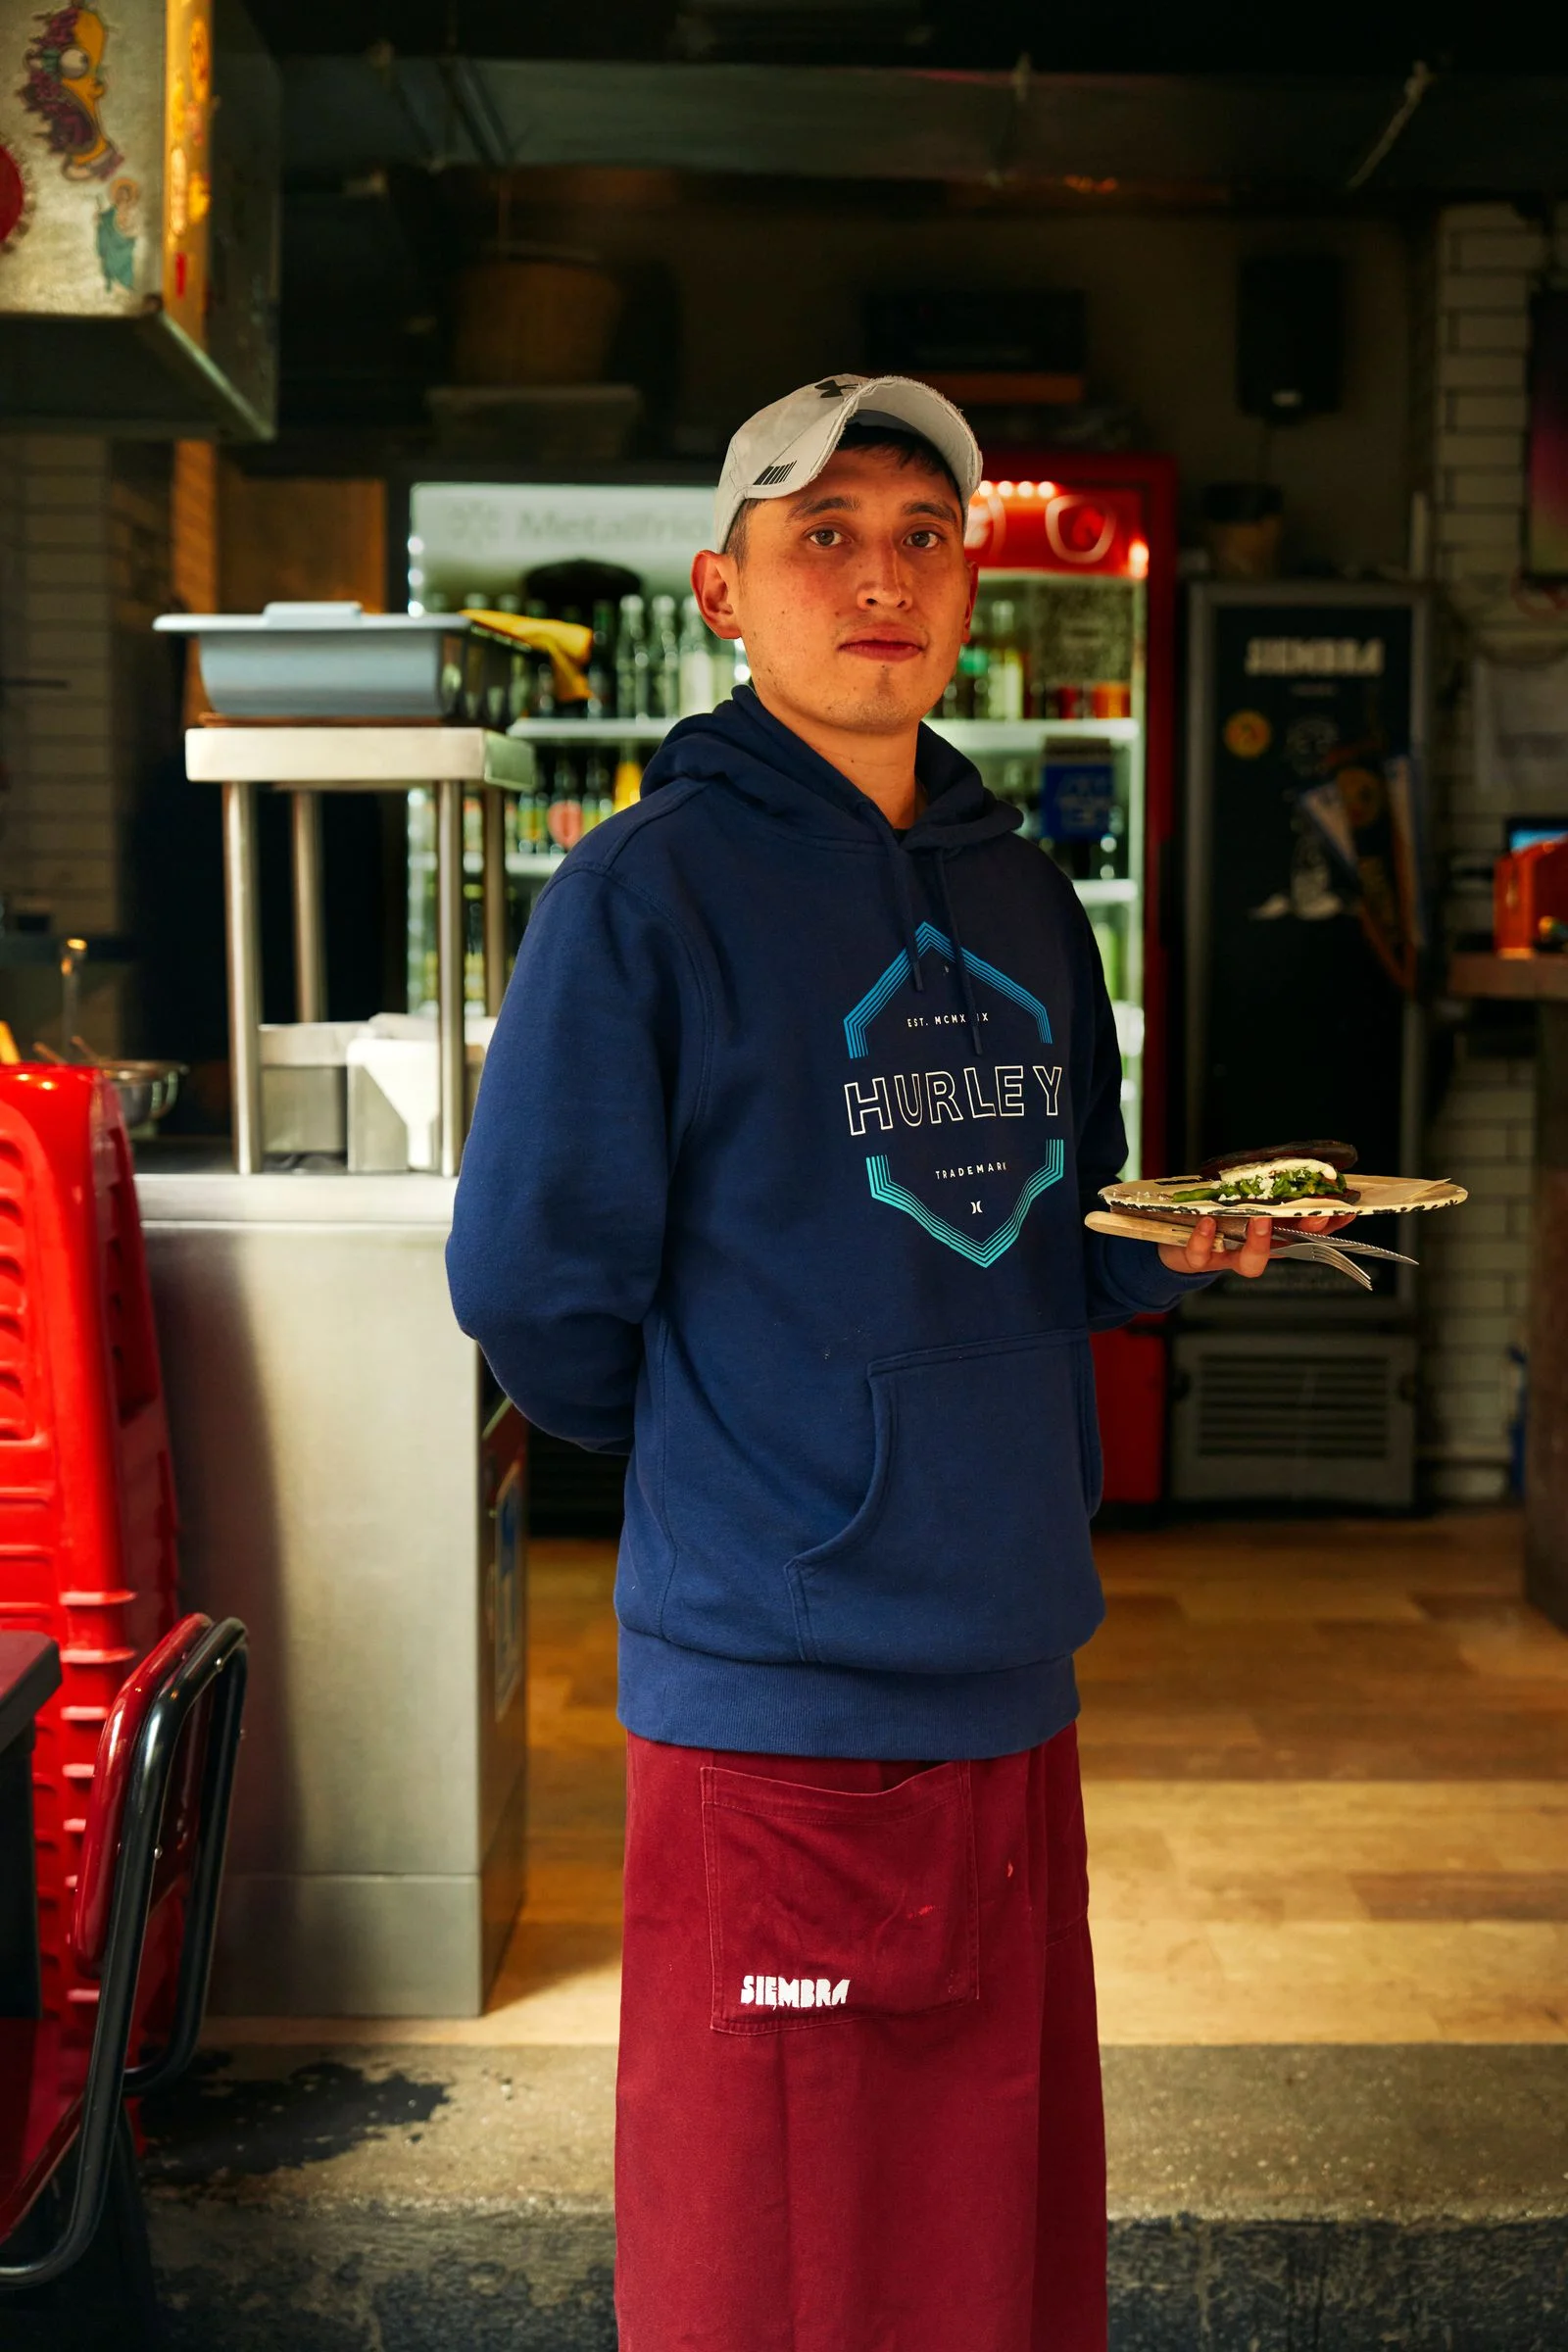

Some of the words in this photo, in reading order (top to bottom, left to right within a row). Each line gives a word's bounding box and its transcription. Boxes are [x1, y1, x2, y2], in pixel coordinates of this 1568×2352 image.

[906, 1017, 929, 1028] EST.
[934, 1012, 989, 1025] MCMXIX
[844, 1065, 1062, 1136] HURLEY
[741, 1975, 851, 2009] SIEMBRA
